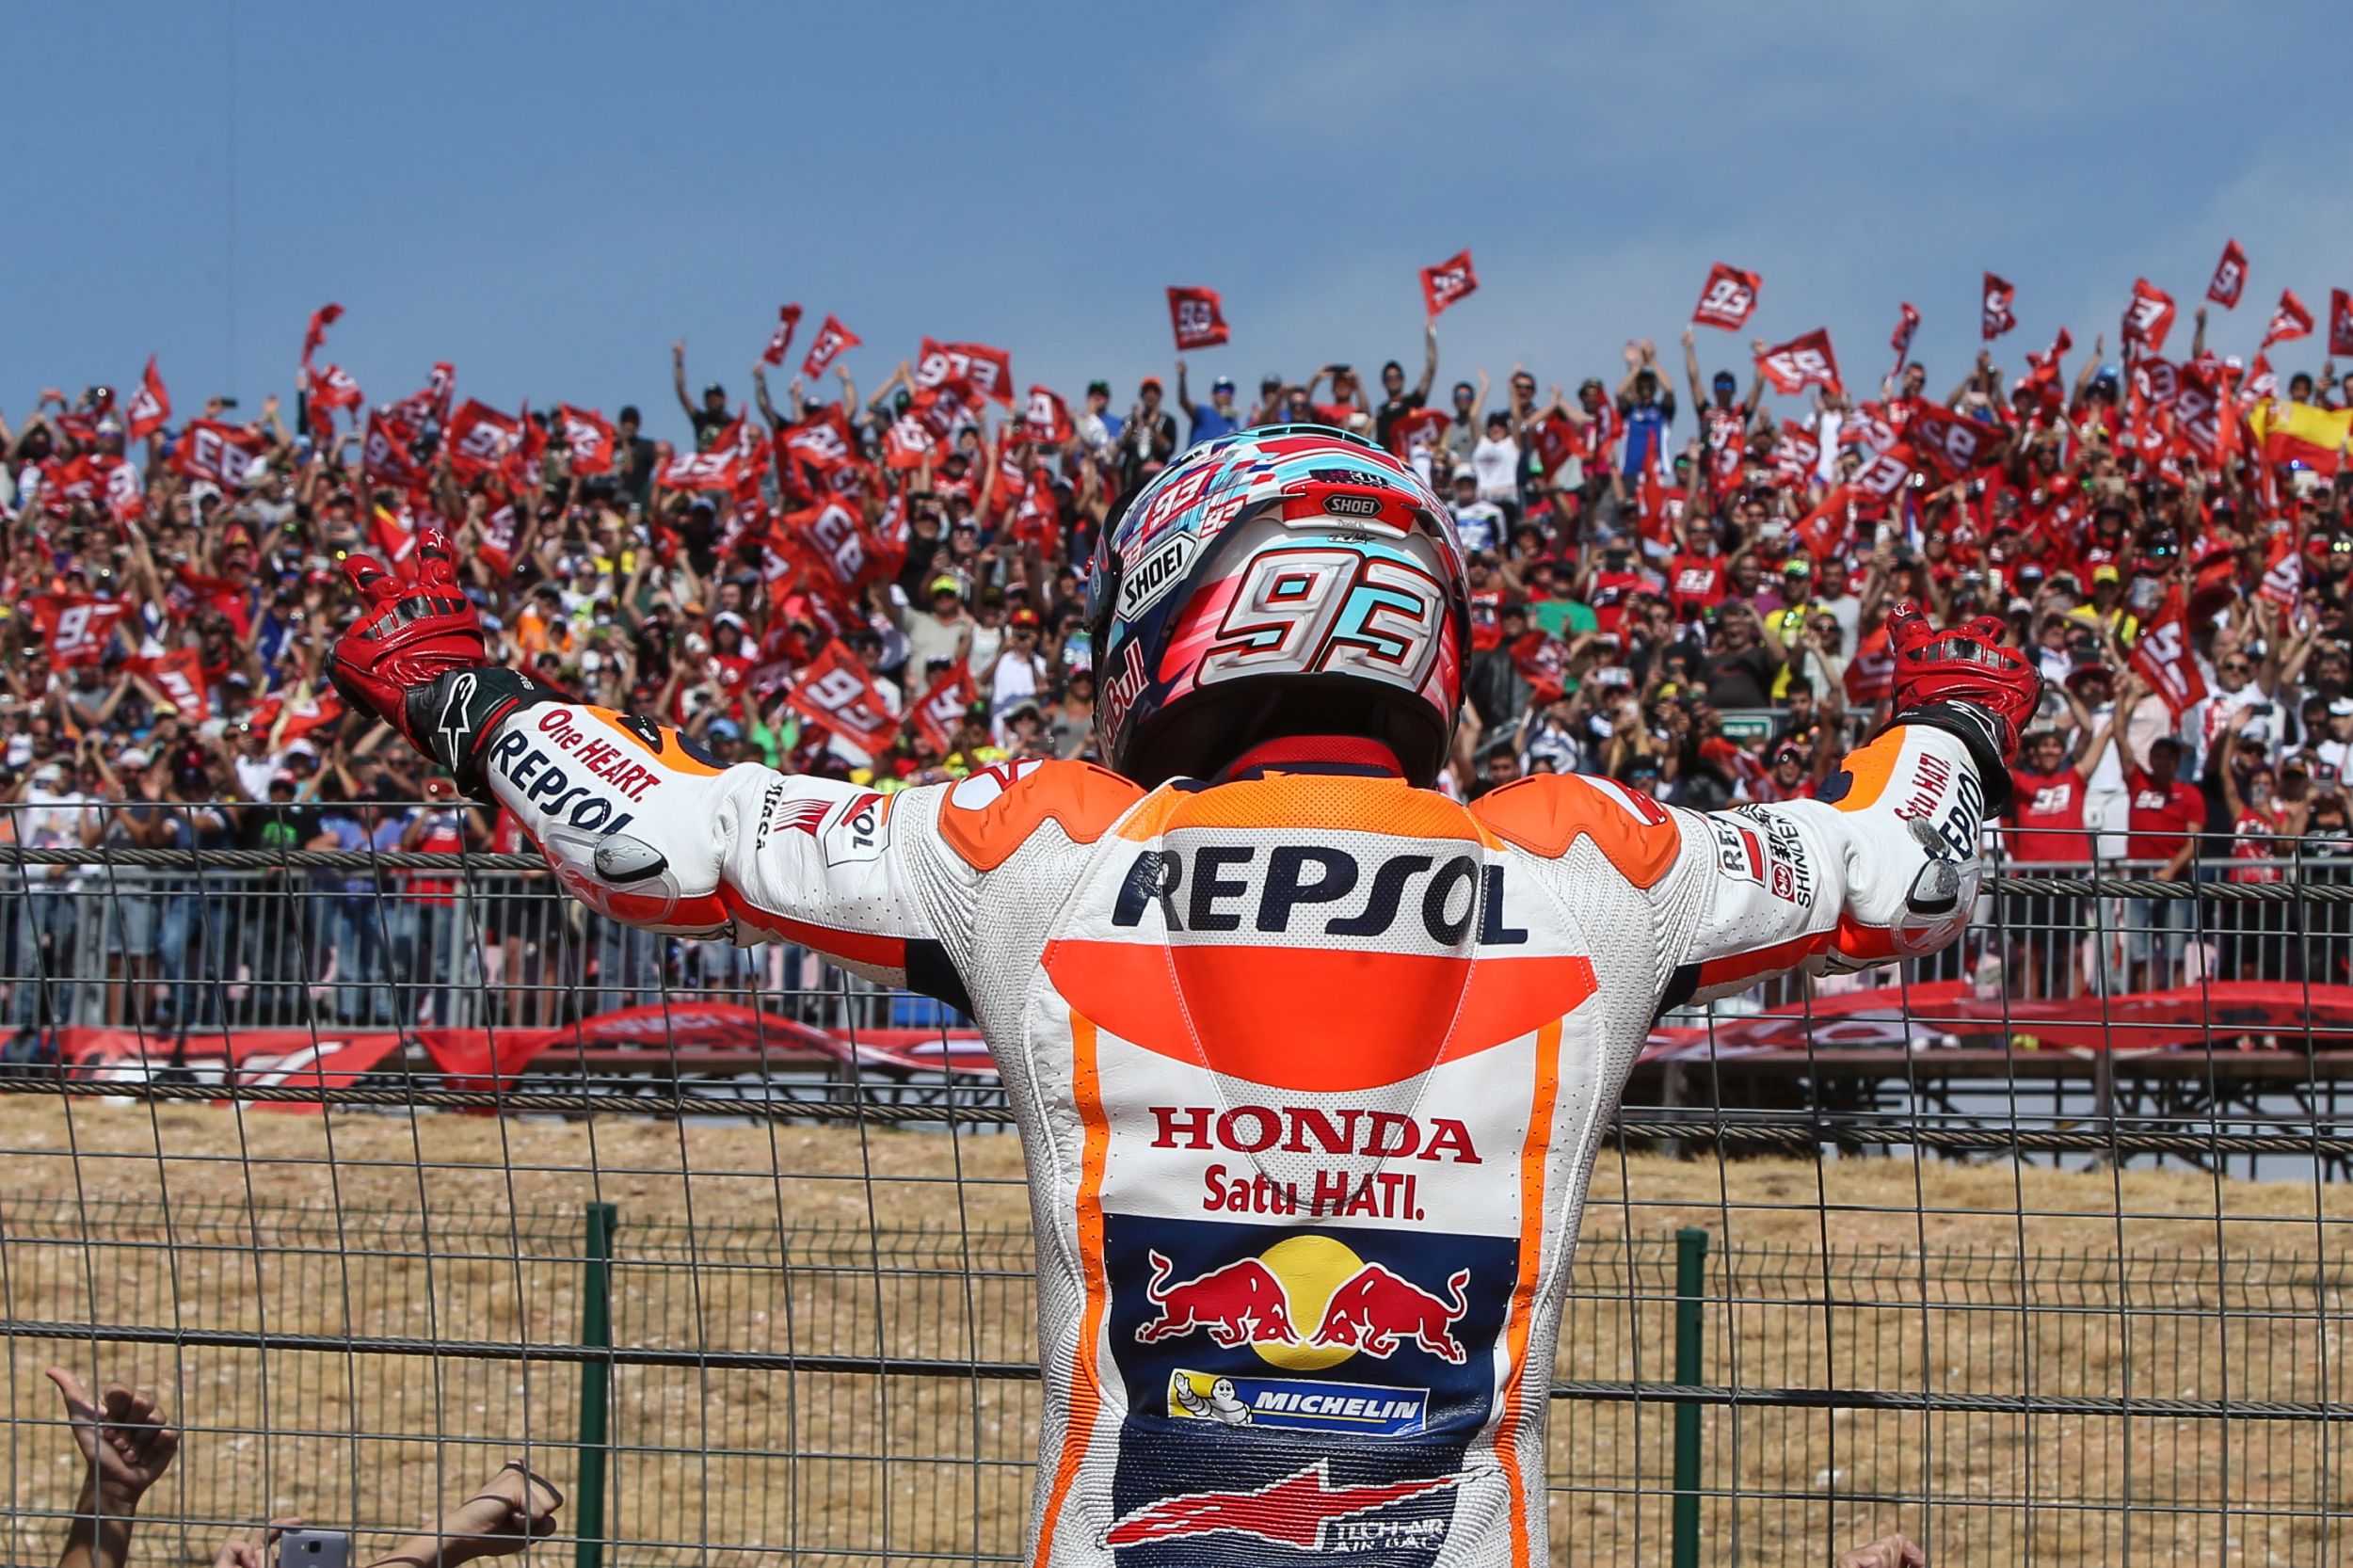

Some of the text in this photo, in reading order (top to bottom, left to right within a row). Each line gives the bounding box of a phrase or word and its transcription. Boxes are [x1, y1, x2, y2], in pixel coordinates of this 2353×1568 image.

[1702, 279, 1752, 316] 93
[1150, 468, 1211, 532] 93
[1331, 498, 1375, 514] SHOEI
[1124, 542, 1183, 612] SHOEI
[1193, 548, 1446, 695] 93
[805, 666, 885, 732] 93
[1102, 637, 1150, 732] Bull
[538, 709, 661, 803] One HEART.
[1112, 846, 1529, 946] REPSOL
[1148, 1106, 1483, 1165] HONDA
[1203, 1164, 1425, 1221] Satu HATI.
[1255, 1390, 1420, 1419] MICHELIN
